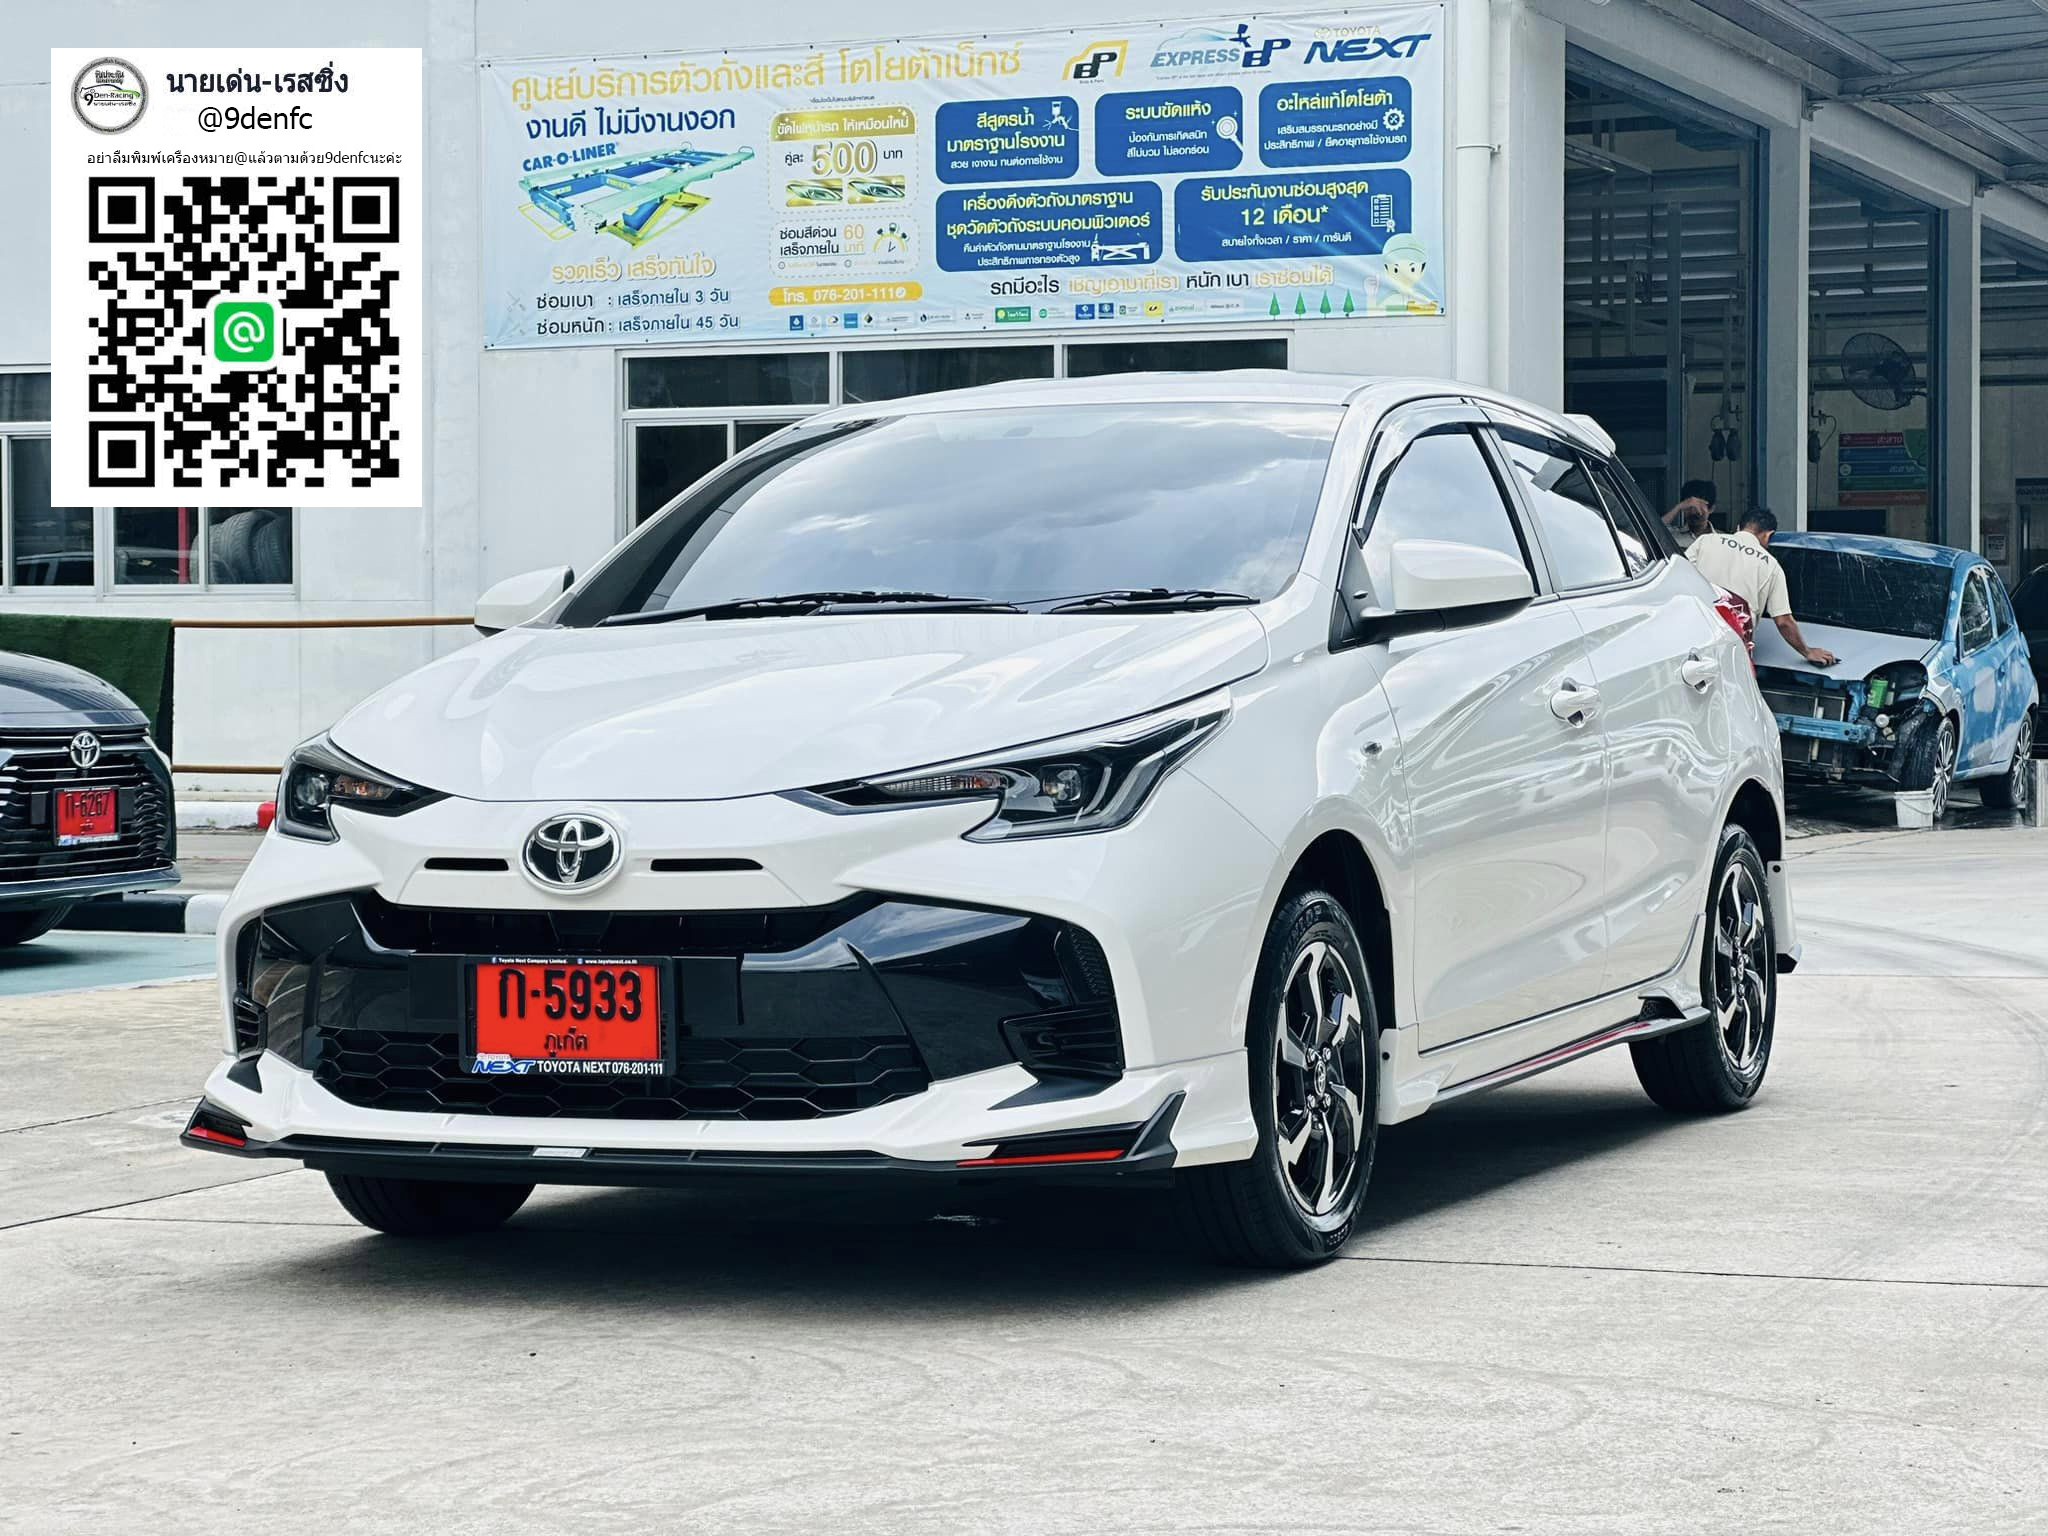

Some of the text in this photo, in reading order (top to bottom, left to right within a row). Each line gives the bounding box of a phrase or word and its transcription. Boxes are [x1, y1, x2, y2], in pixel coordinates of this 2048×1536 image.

[1333, 25, 1381, 37] TOYOTA
[1150, 48, 1240, 68] EXPRESS
[1303, 33, 1432, 64] NEXT
[512, 52, 824, 111] ศูนย์บริการตัวถังและสี
[1125, 100, 1212, 120] ระบบขัดแห้ง
[1276, 88, 1393, 111] อะไหล่แท้โตโยต้า
[526, 106, 735, 139] งานดี ไม่มีงานงอก
[976, 107, 1035, 131] สีสูตรน้ำ
[947, 132, 1065, 154] มาตราฐานโรงงาน
[784, 140, 903, 176] คู่ละ 500 บาท
[950, 158, 969, 169] สวย
[1000, 155, 1063, 167] ทนต่อการใช้งาน
[962, 191, 1133, 212] เครื่องดึงตัวถังมาตราฐาน
[1200, 181, 1369, 201] รับประกันงานซ่อมสูงสุด
[947, 212, 1150, 239] ชุดวัดตัวถังระบบคอมพิวเตอร์
[1240, 208, 1265, 226] 12
[779, 223, 865, 240] ซ่อมสีด่วน 60
[1292, 234, 1312, 244] ราคา
[780, 240, 839, 256] เสร็จภายใน
[552, 256, 622, 284] รวดเร็ว
[990, 274, 1060, 295] รถมีอะไร
[1186, 271, 1221, 288] หนัก
[1226, 272, 1249, 287] เบา
[536, 292, 593, 309] ซ่อมเบา
[617, 287, 689, 306] เสร็จภายใน
[695, 289, 704, 302] 3
[710, 288, 729, 302] วัน
[783, 288, 808, 304] โทร.
[536, 317, 605, 335] ซ่อมหนัก
[618, 314, 690, 332] เสร็จภายใน
[695, 315, 713, 328] 45
[719, 314, 739, 328] วัน
[1720, 537, 1769, 564] TOYOTA
[499, 967, 642, 1021] ก-5933
[544, 1026, 588, 1057] ภูเก็ต
[472, 1060, 663, 1075] NEXT TOYOTA NEXT 076-201-111
